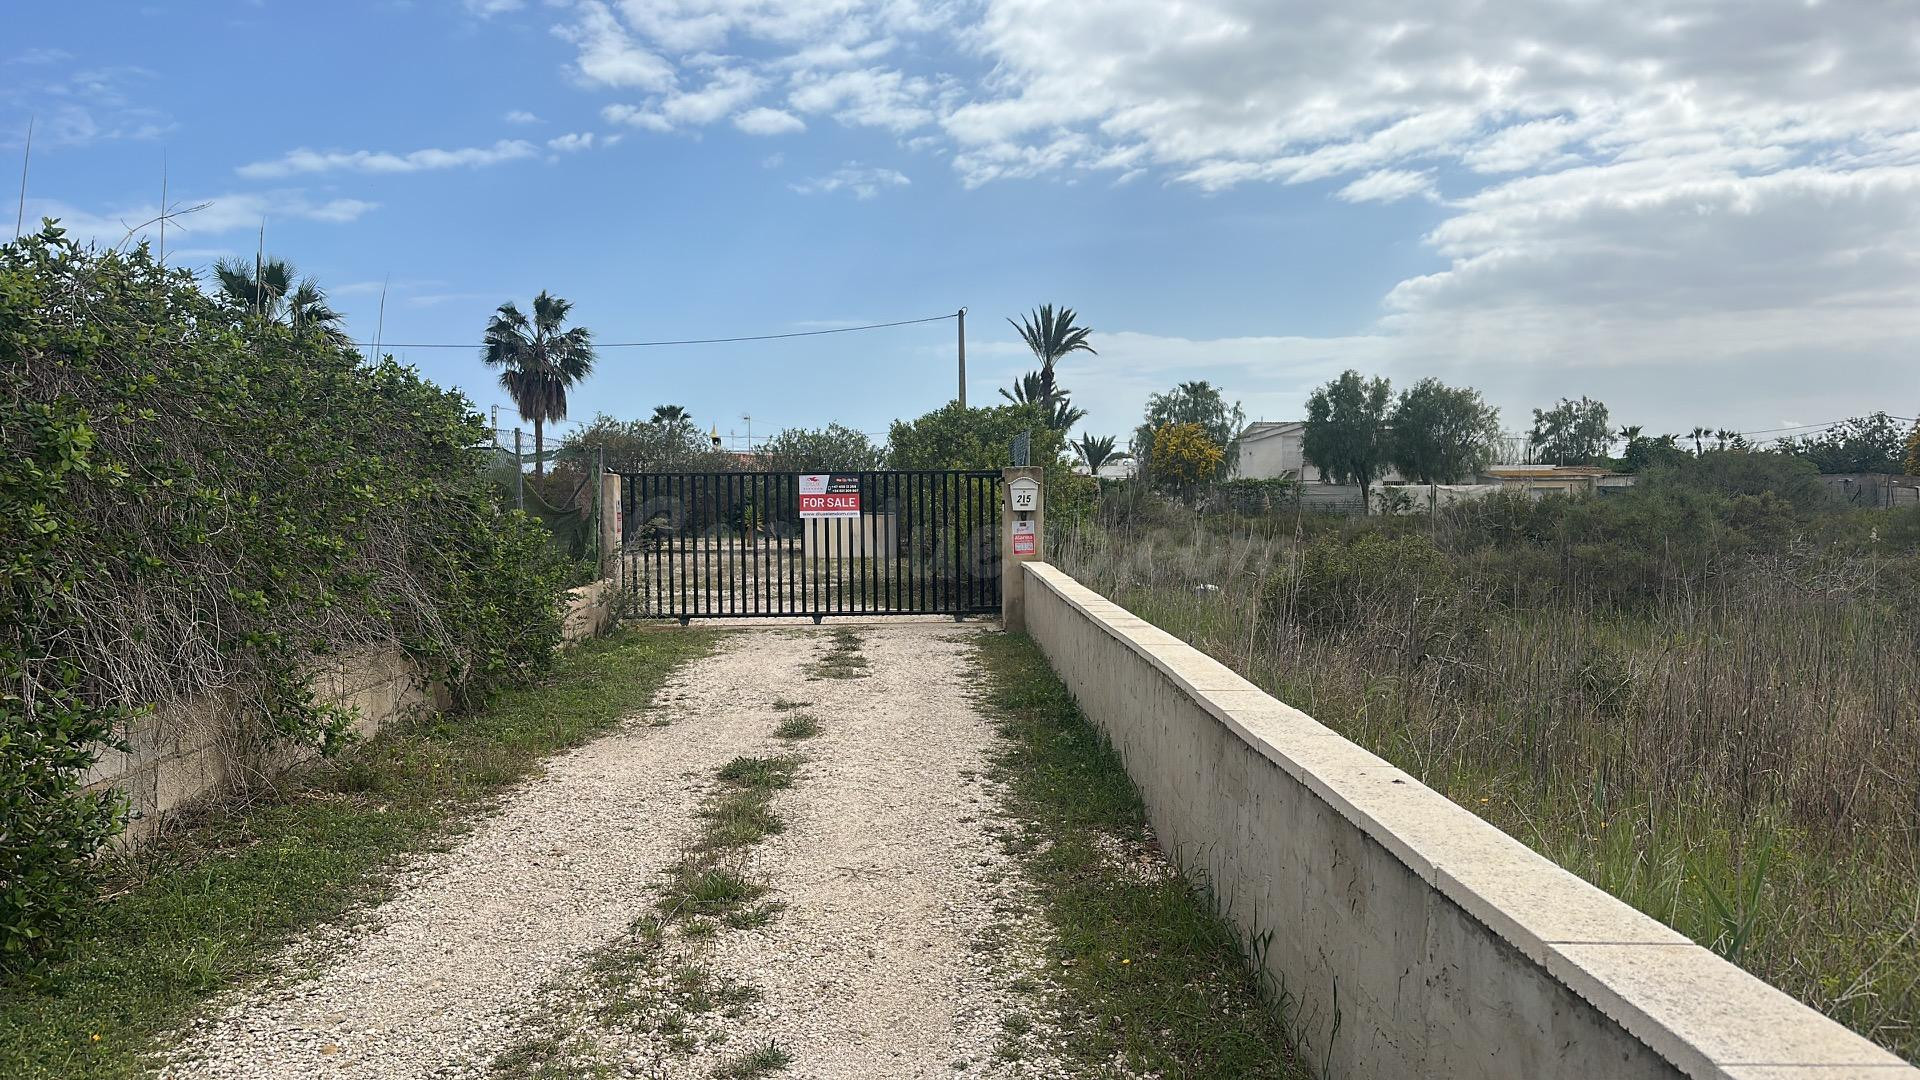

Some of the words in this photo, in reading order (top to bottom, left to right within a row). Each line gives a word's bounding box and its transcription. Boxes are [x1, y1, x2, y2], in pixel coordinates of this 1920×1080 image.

[803, 498, 824, 507] FOR
[827, 498, 855, 507] SALE
[1017, 495, 1031, 503] 215
